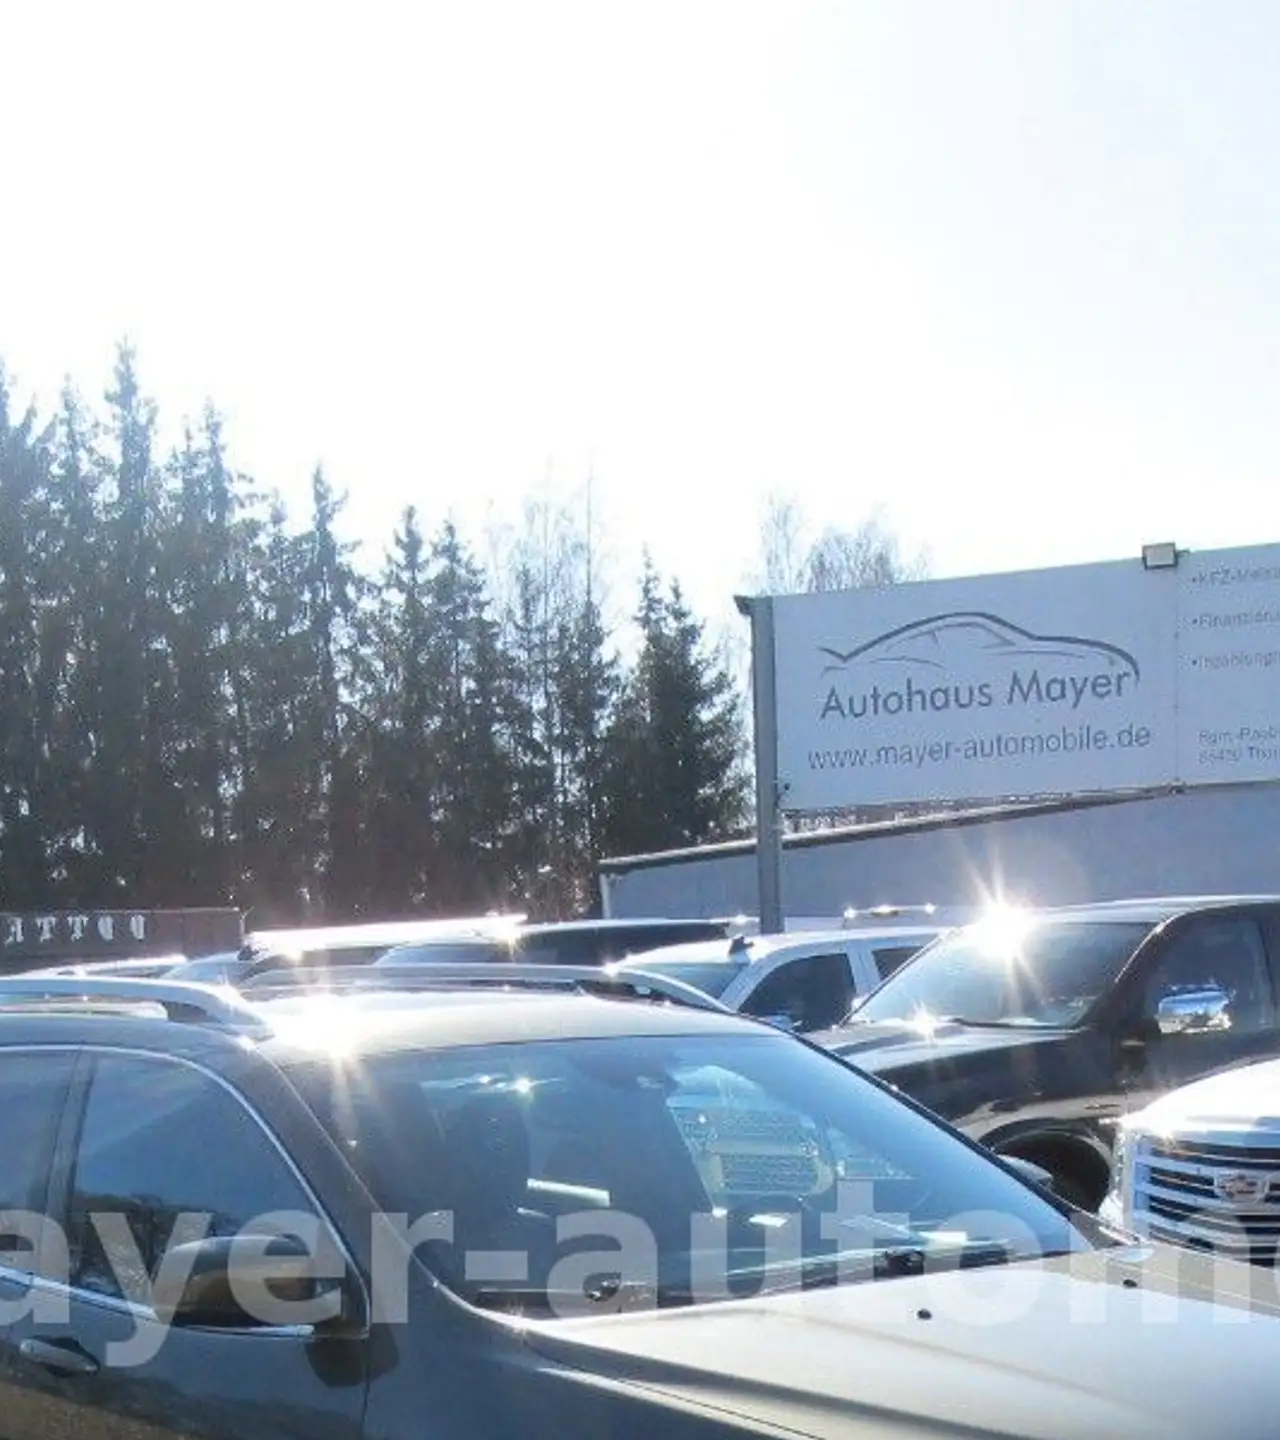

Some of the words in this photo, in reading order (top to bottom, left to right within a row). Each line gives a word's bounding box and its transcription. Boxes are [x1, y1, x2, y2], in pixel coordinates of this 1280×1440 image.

[821, 678, 992, 719] Autohaus
[1007, 669, 1131, 709] Mayer
[808, 723, 1151, 769] www.mayer-automobile.de
